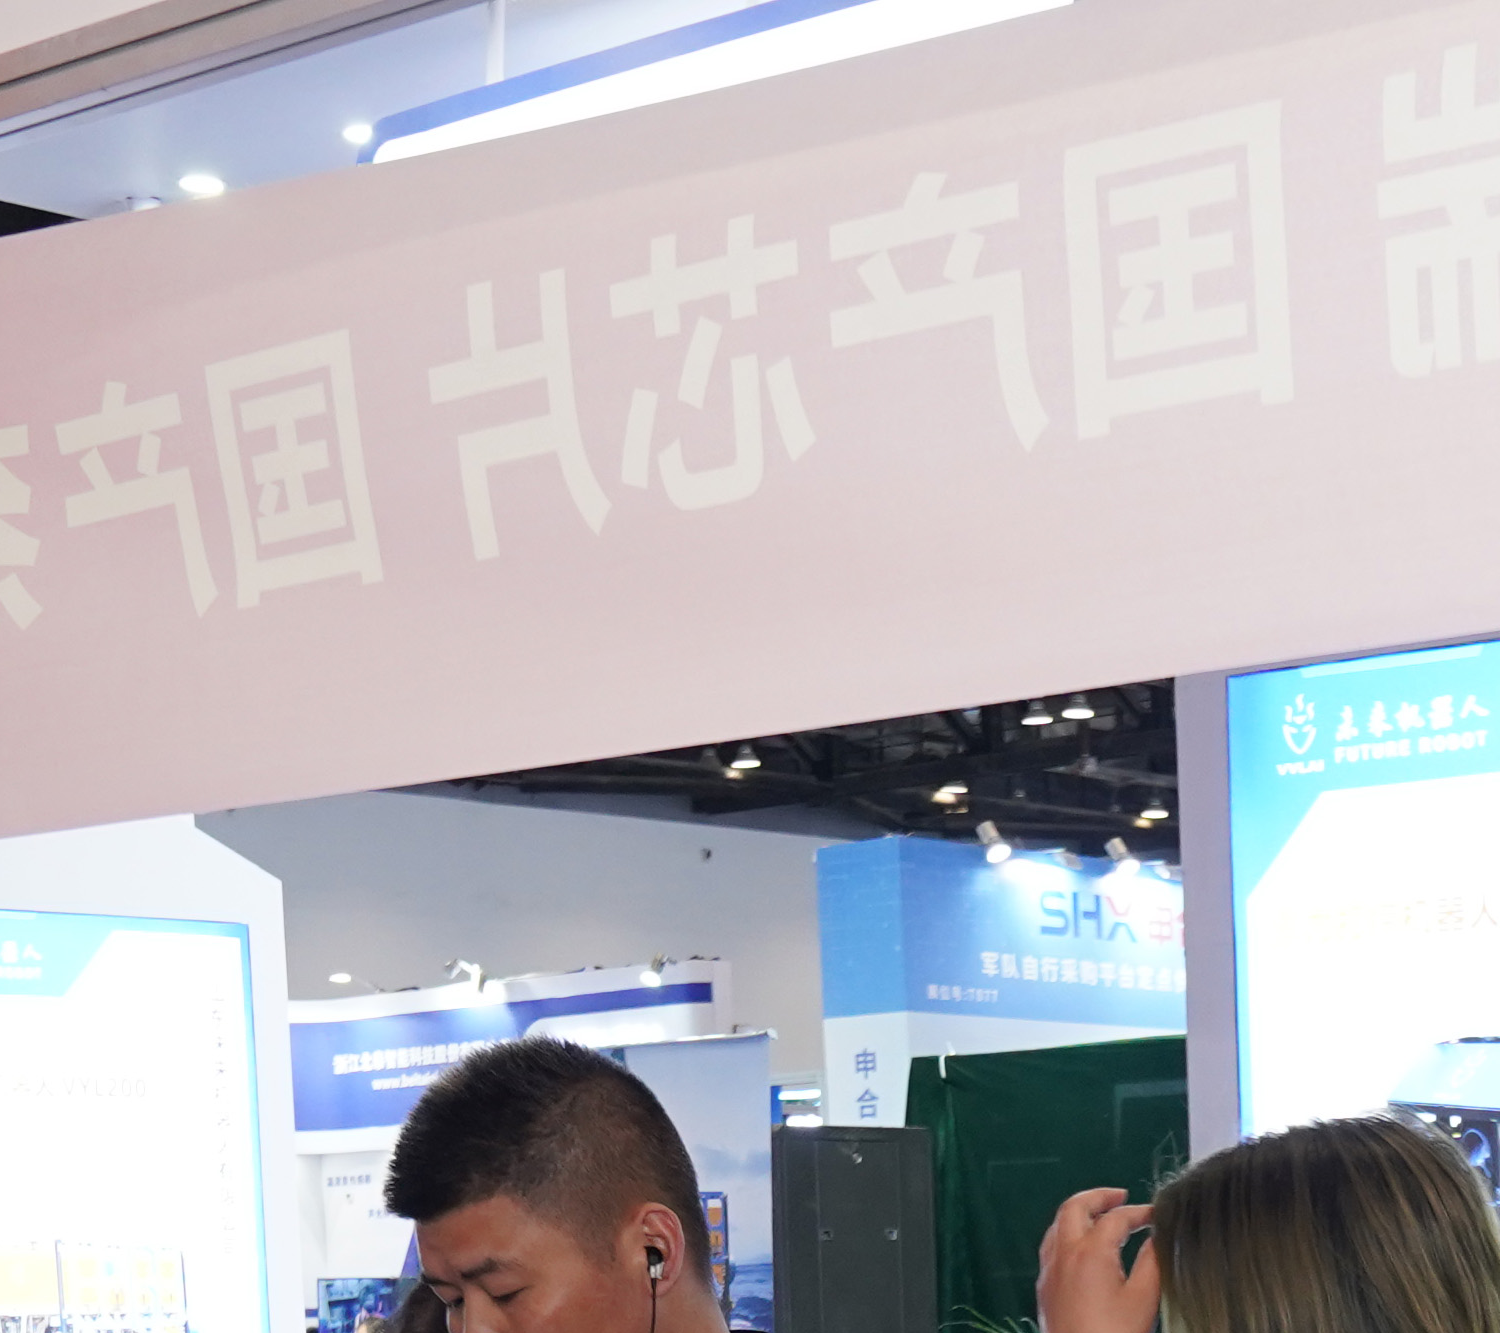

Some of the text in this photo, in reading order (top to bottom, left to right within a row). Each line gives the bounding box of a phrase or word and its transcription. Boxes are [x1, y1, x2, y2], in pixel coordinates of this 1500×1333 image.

[1334, 694, 1491, 742] 未来机器人
[1333, 730, 1488, 764] FUTURE ROBOT
[1040, 890, 1138, 943] SHX
